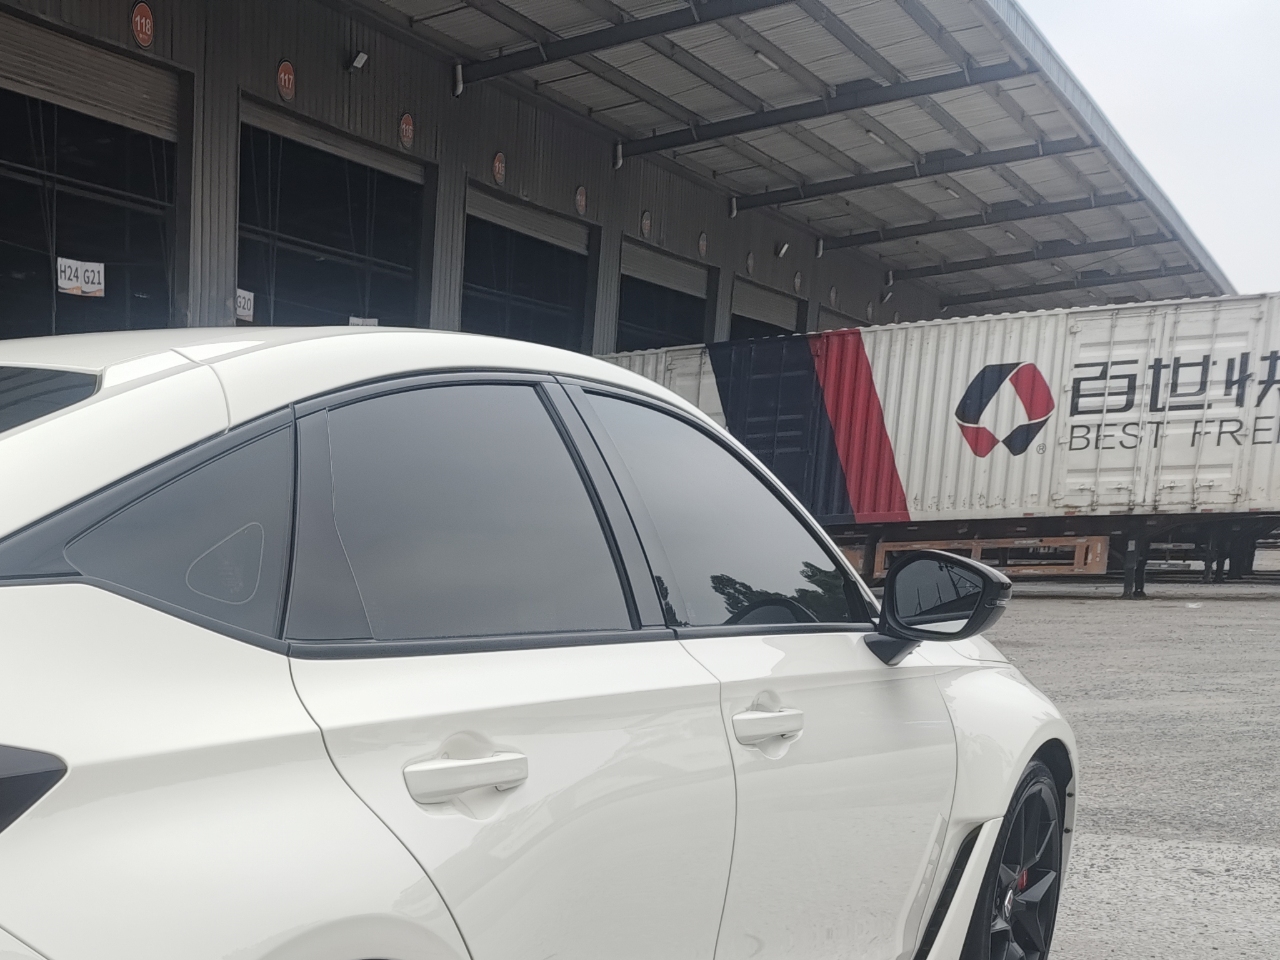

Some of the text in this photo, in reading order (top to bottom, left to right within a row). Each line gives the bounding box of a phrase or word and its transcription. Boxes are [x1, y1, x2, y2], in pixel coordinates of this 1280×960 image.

[135, 15, 152, 35] 118
[280, 72, 294, 89] 117
[59, 263, 79, 283] H24
[83, 268, 102, 285] G21
[236, 295, 252, 312] G20
[1068, 420, 1171, 451] BEST
